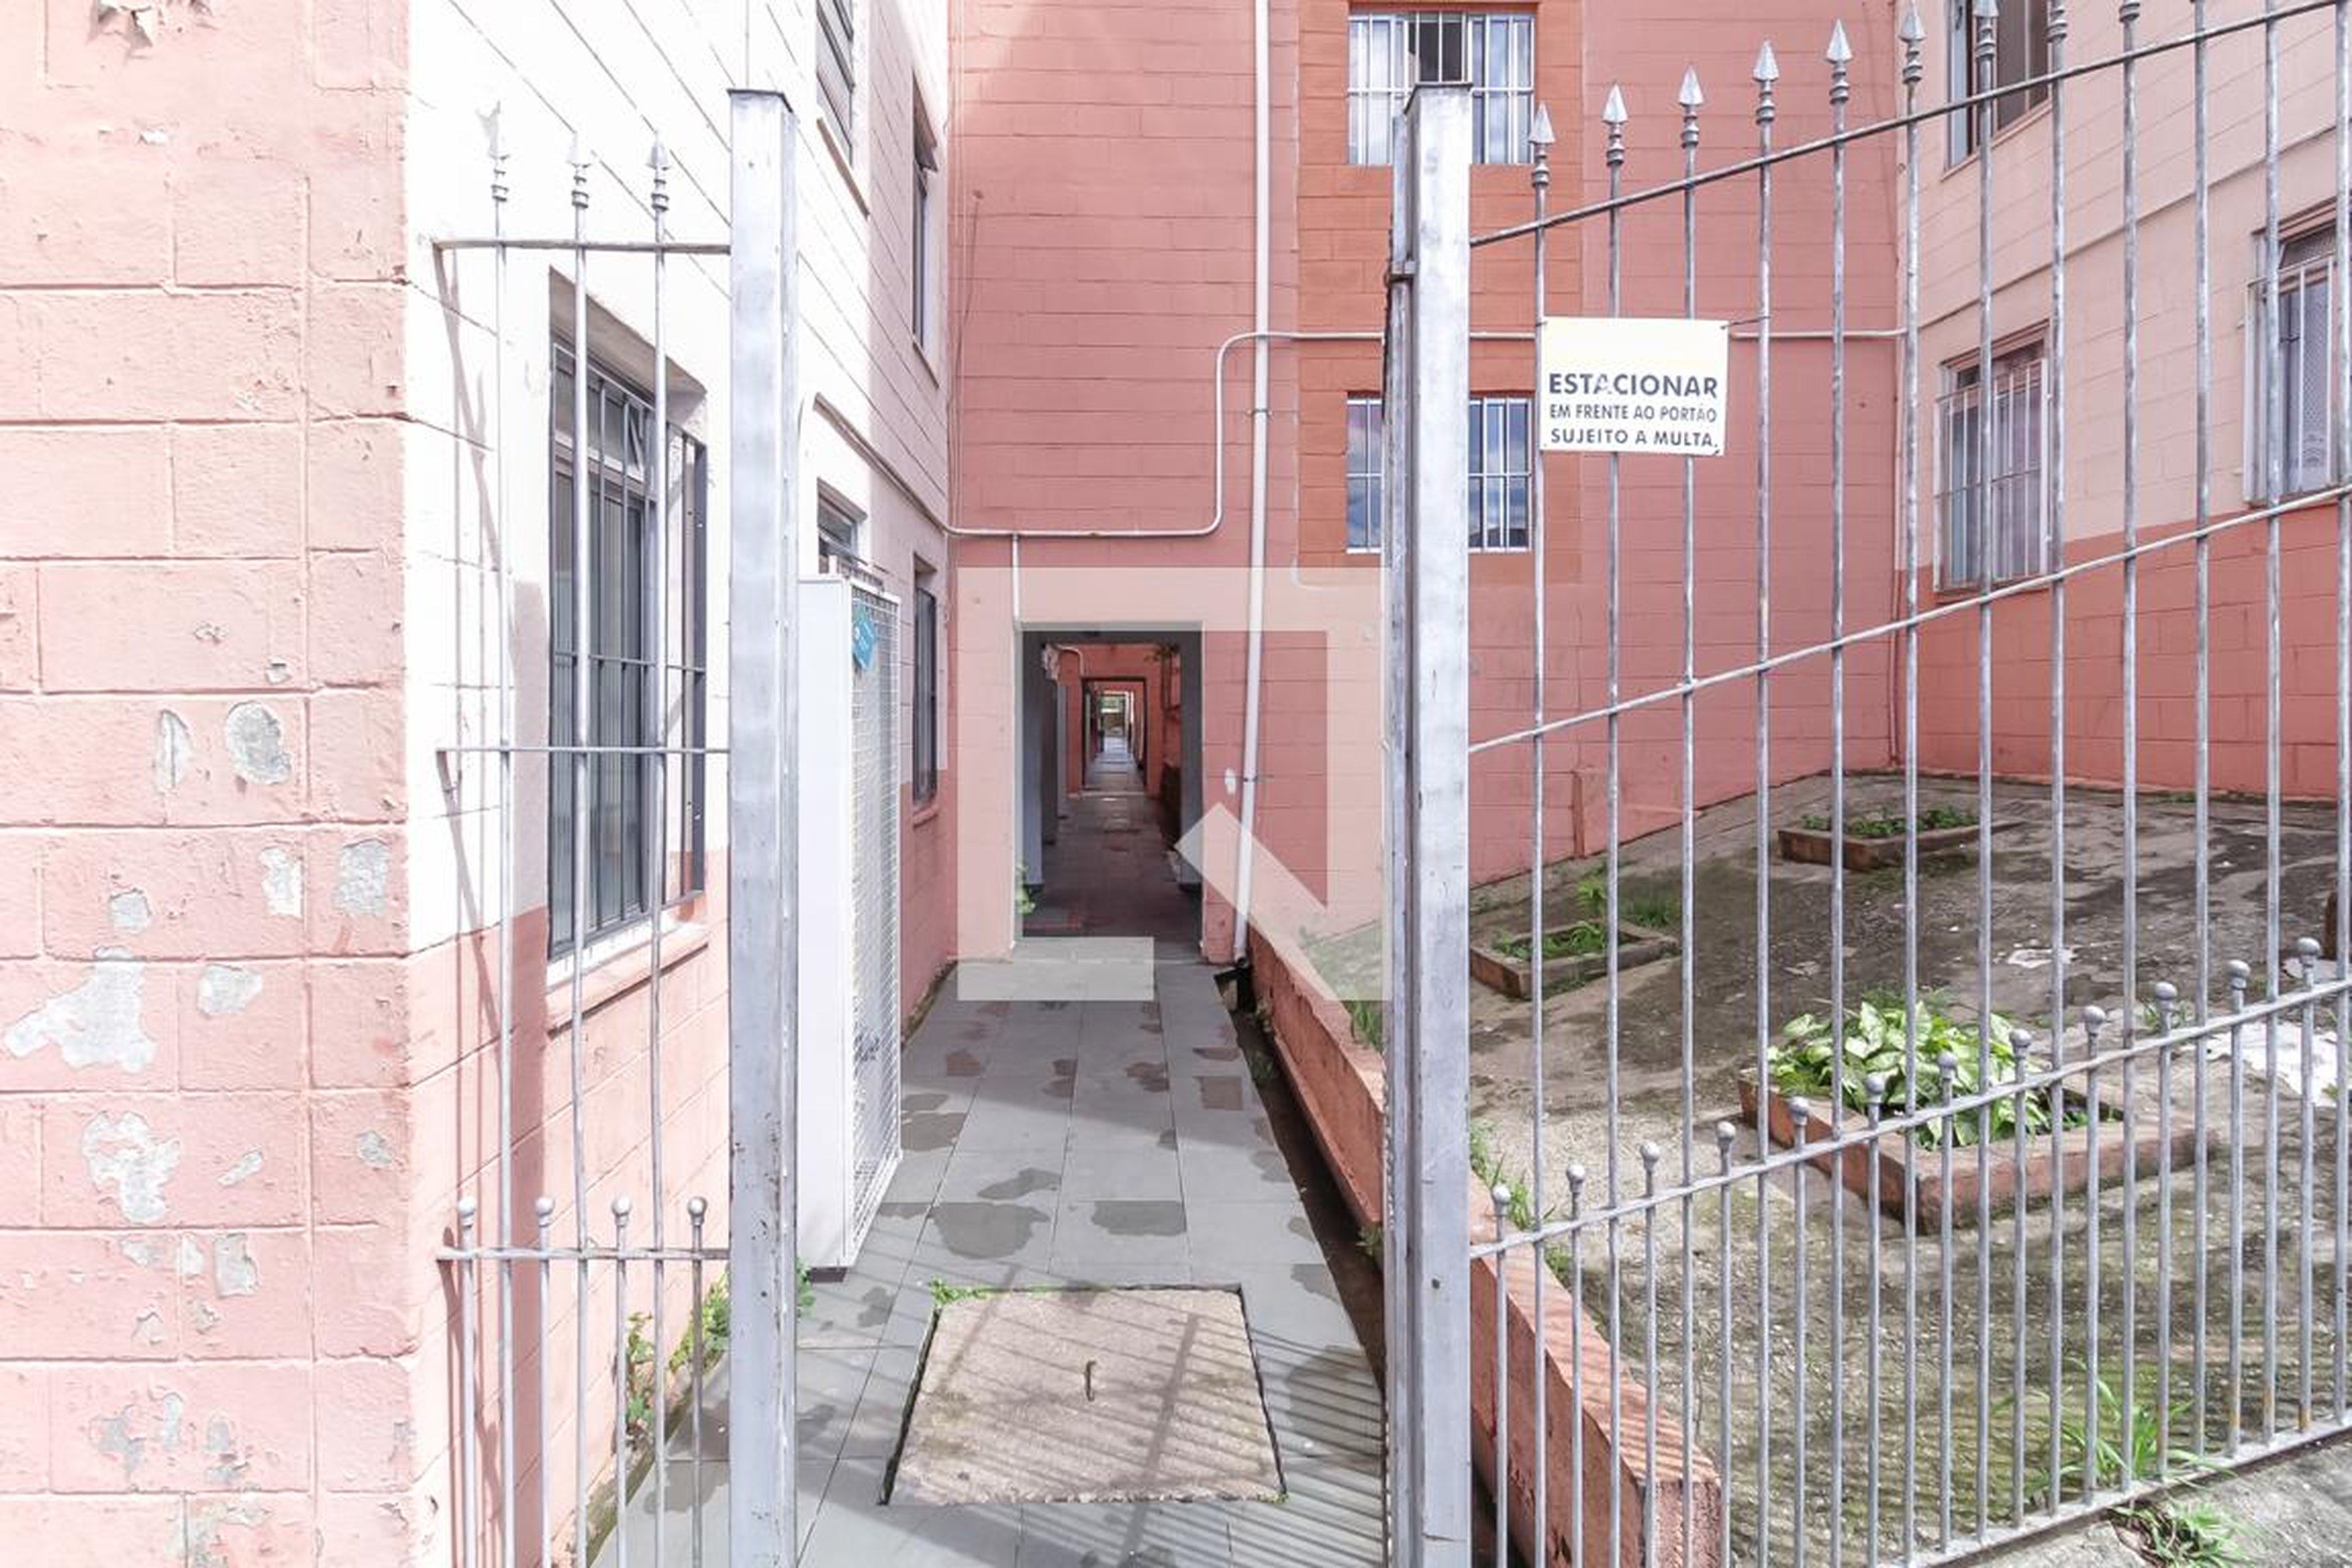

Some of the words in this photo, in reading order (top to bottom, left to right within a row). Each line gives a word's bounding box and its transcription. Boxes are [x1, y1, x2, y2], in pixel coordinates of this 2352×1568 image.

[1550, 373, 1717, 398] ESTACIONAR
[1550, 404, 1570, 418] EM
[1576, 404, 1629, 419] FRENTE
[1634, 405, 1654, 420] AO
[1551, 429, 1628, 443] SUJEITO
[1635, 431, 1647, 444] A
[1654, 431, 1717, 448] MULTA.
